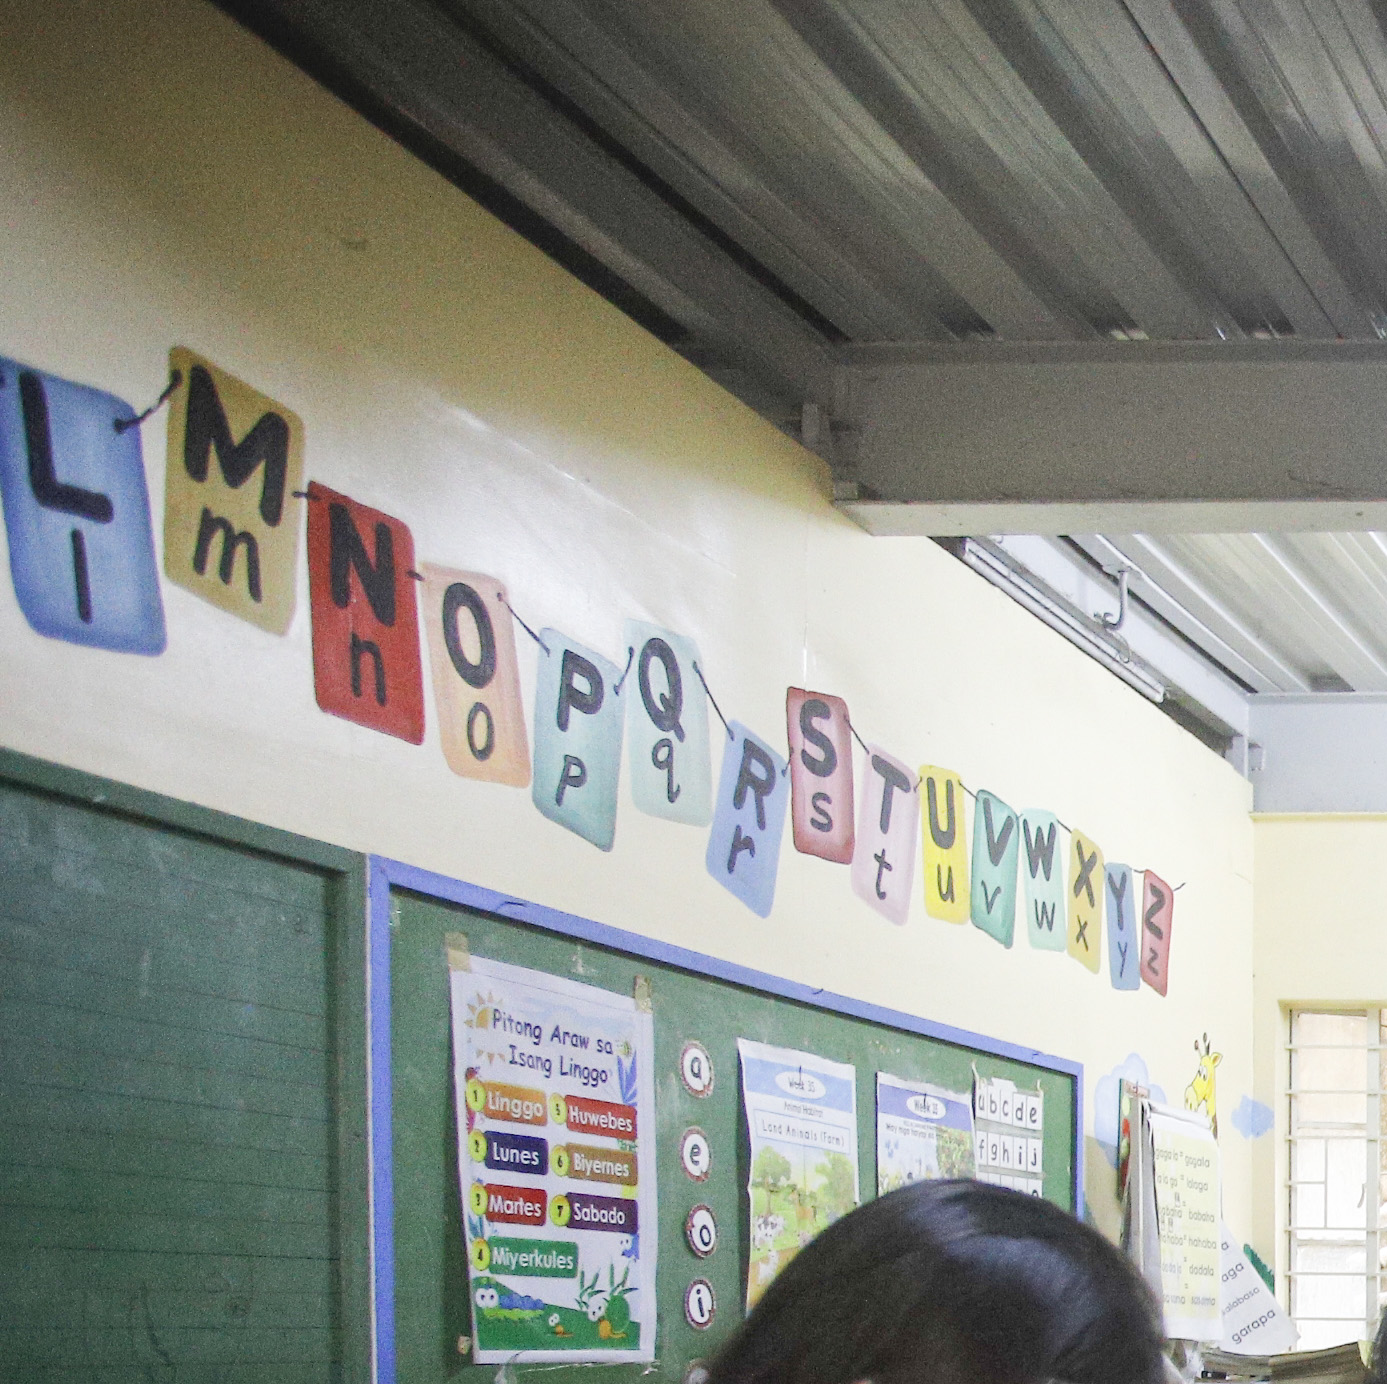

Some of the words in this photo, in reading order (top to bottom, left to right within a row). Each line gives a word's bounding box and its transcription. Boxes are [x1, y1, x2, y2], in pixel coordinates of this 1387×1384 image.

[19, 371, 115, 524] L
[184, 364, 291, 528] M
[328, 501, 396, 628] N
[441, 582, 498, 690] O
[557, 648, 606, 733] P
[638, 636, 685, 742] Q
[798, 698, 838, 778] S
[733, 736, 776, 831] R
[871, 753, 912, 836] T
[926, 776, 957, 850] U
[982, 795, 1016, 867] V
[1022, 818, 1057, 883] W
[1072, 837, 1098, 909] X
[1109, 870, 1130, 931] Y
[1143, 883, 1166, 941] Z
[492, 1008, 543, 1046] Pitong
[550, 1024, 590, 1050] Araw
[596, 1038, 614, 1055] sa
[508, 1044, 553, 1079] Isang
[559, 1054, 609, 1088] Linggo
[487, 1091, 544, 1121] Linggo
[989, 1092, 998, 1114] b
[1002, 1099, 1009, 1117] c
[1015, 1101, 1024, 1122] d
[1029, 1106, 1037, 1124] e
[567, 1104, 634, 1133] Huwebes
[762, 1119, 783, 1138] Land
[785, 1123, 818, 1143] Animals
[492, 1141, 540, 1166] Lunes
[690, 1143, 703, 1167] e
[979, 1138, 985, 1160] f
[990, 1143, 998, 1161] g
[1002, 1141, 1010, 1164] h
[1018, 1145, 1022, 1165] i
[1030, 1147, 1037, 1166] j
[573, 1153, 631, 1178] Biyernes
[488, 1193, 543, 1218] Martes
[573, 1202, 627, 1226] Sabado
[699, 1224, 712, 1247] o
[491, 1246, 575, 1271] Miyerkules
[695, 1288, 706, 1317] i
[1231, 1308, 1277, 1345] garapa
